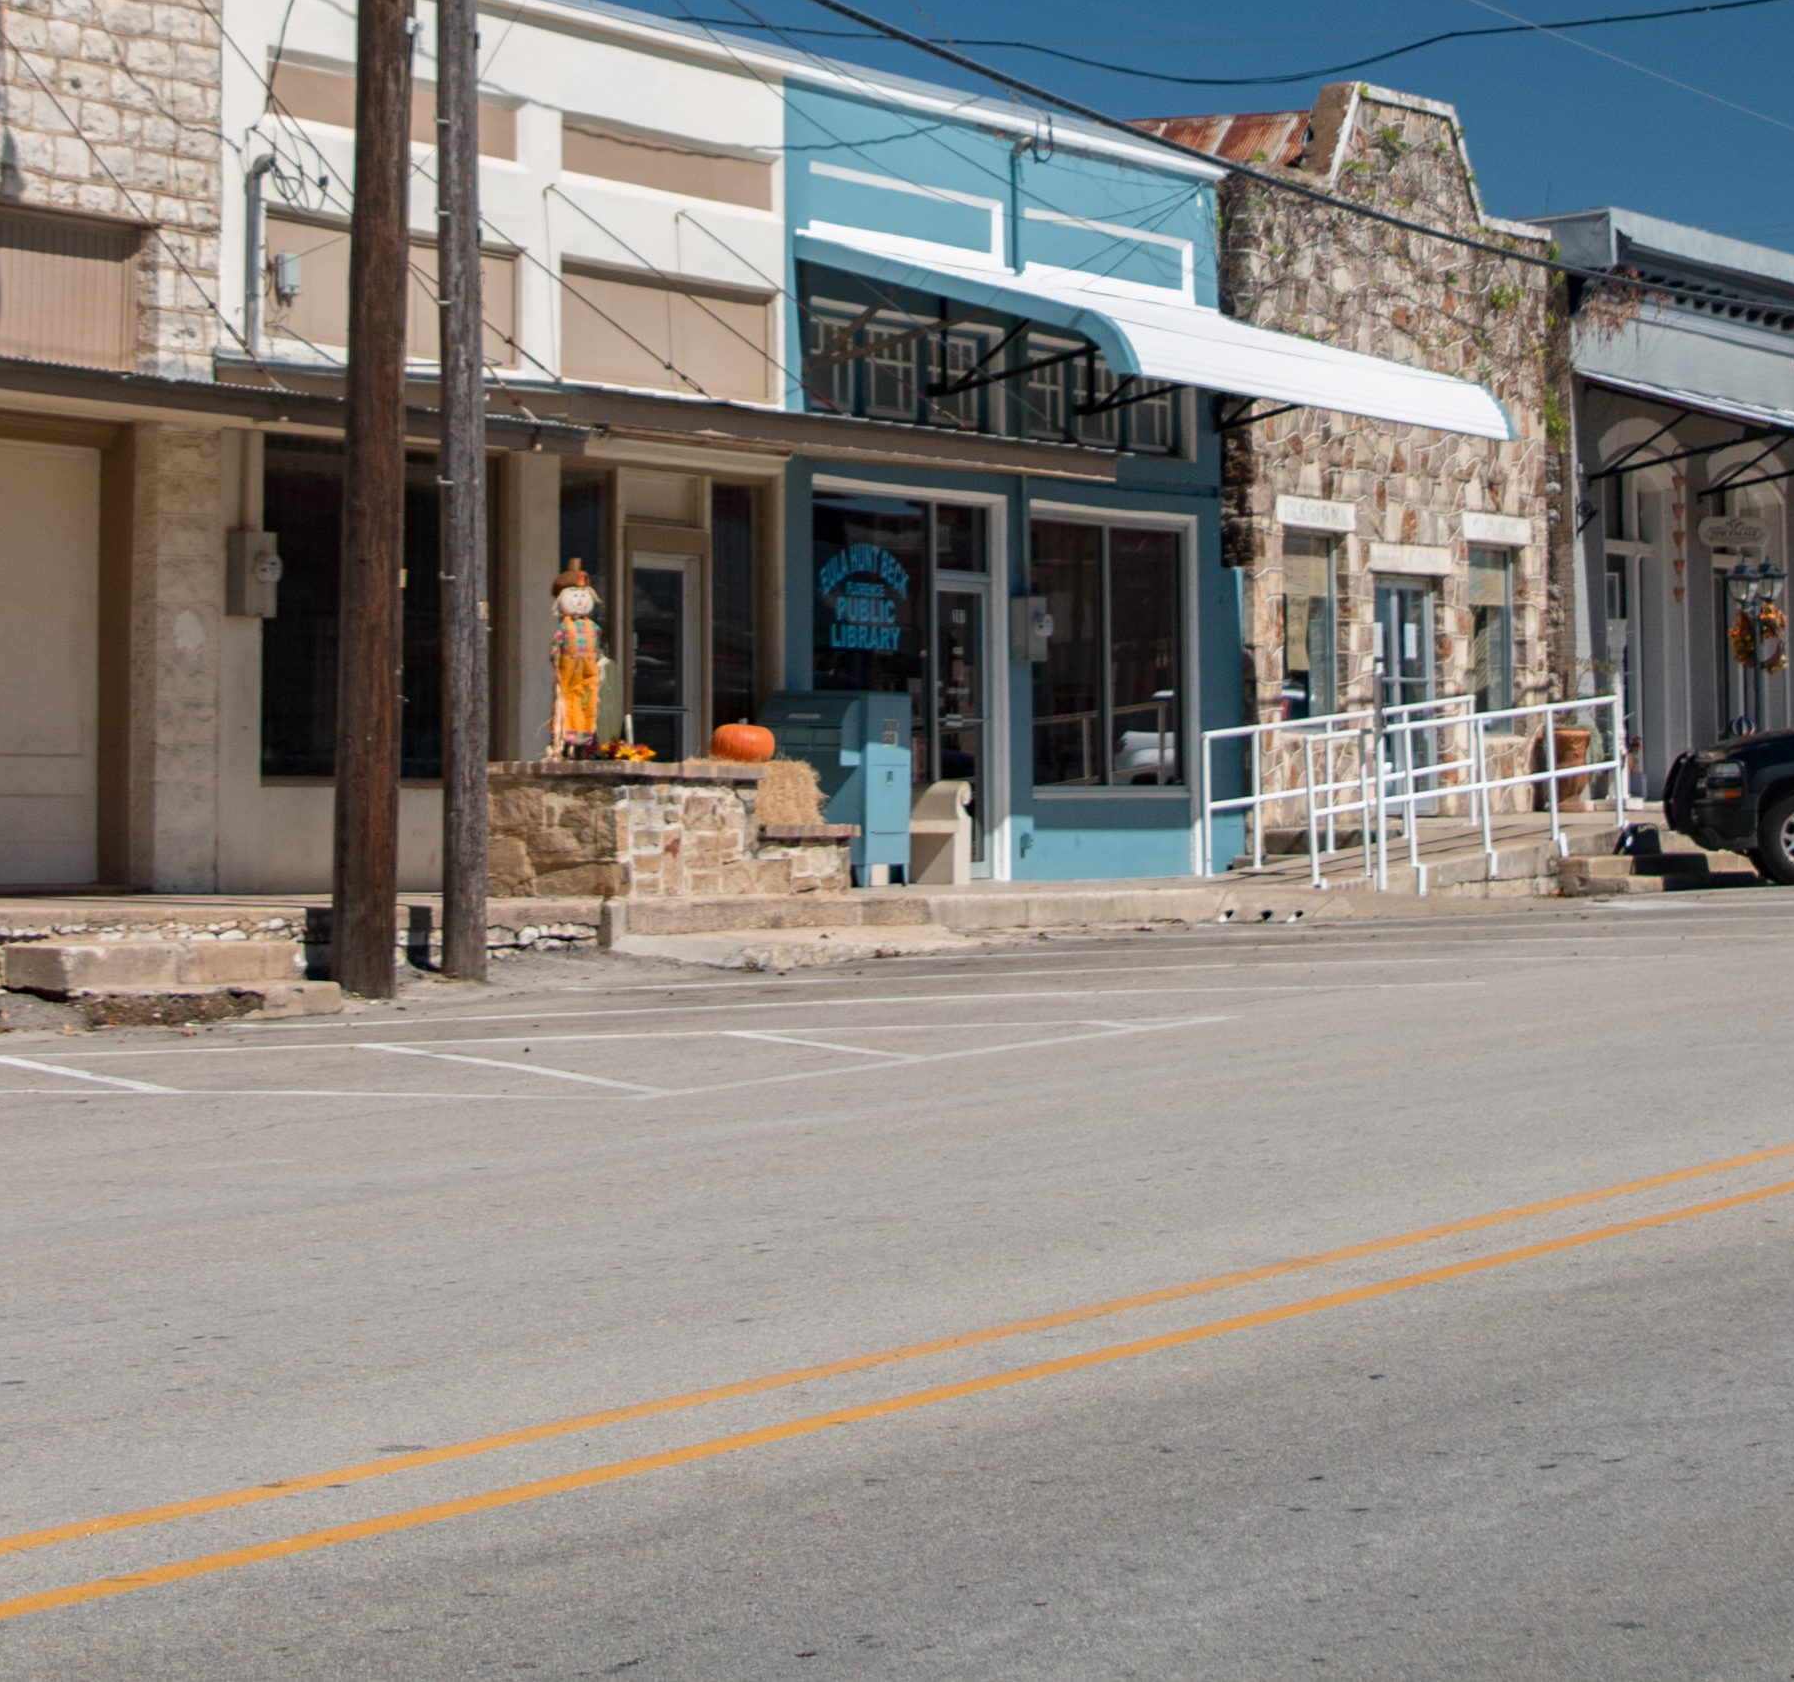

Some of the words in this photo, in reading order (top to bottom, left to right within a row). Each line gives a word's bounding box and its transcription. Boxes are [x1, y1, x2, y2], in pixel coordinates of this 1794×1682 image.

[819, 548, 850, 595] EULA
[849, 543, 881, 573] HUNT
[880, 549, 910, 600] BECK
[835, 597, 896, 624] PUBLIC
[830, 623, 902, 651] LIBRARY
